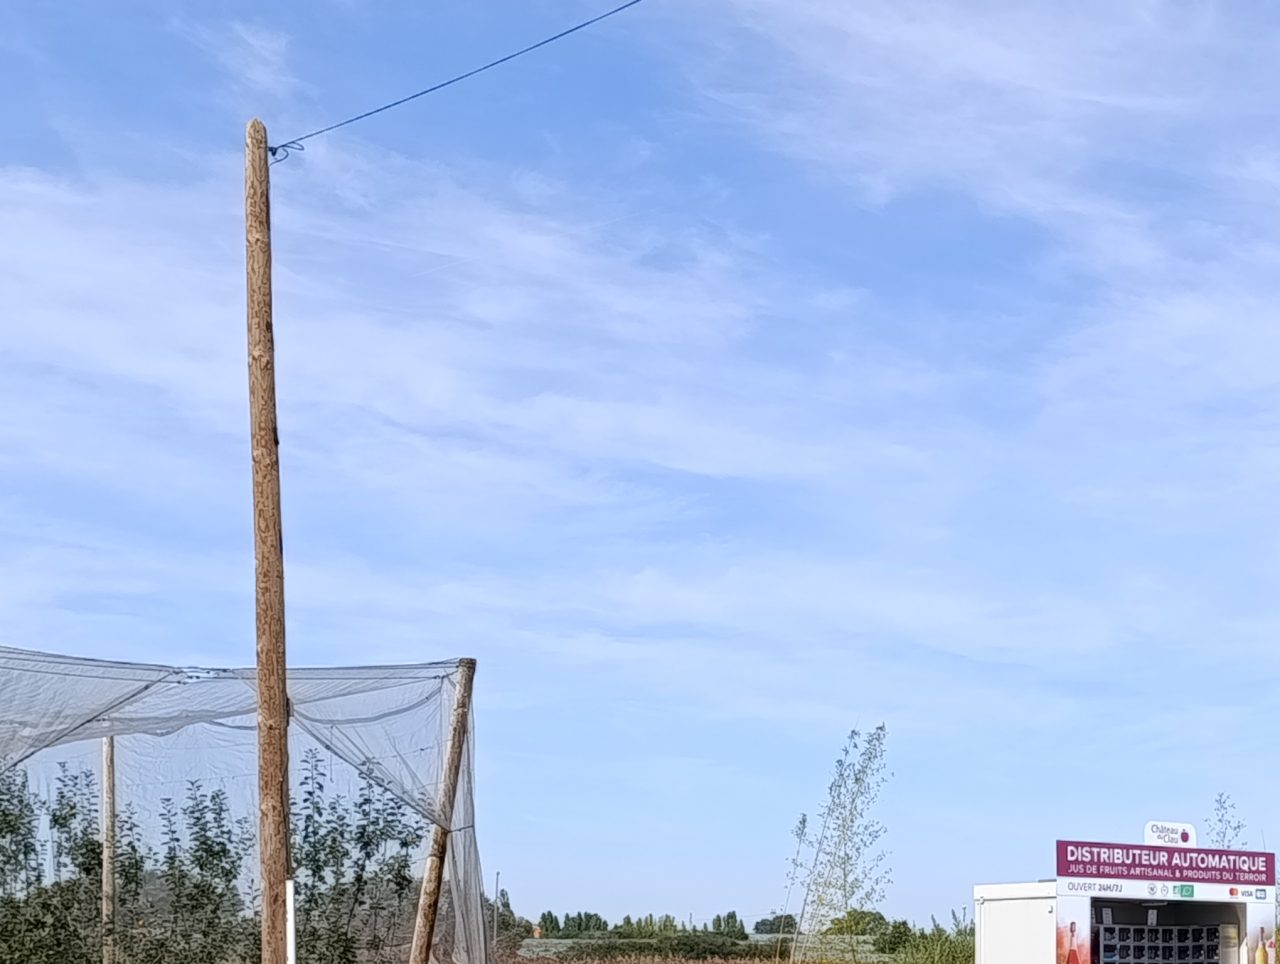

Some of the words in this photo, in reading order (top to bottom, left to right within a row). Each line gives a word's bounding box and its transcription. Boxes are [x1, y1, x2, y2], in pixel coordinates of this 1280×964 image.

[1151, 824, 1179, 835] Château
[1066, 845, 1169, 867] DISTRIBUTEUR
[1171, 851, 1267, 872] AUTOMATIQUE
[1068, 864, 1085, 874] JUS
[1086, 864, 1098, 875] DE
[1099, 865, 1128, 876] FRUITS
[1129, 867, 1173, 878] ARTISANAL
[1175, 869, 1181, 878] &
[1182, 869, 1221, 880] PRODUITS
[1222, 871, 1235, 881] DU
[1235, 872, 1267, 882] TERROIR
[1067, 881, 1097, 892] OUVERT
